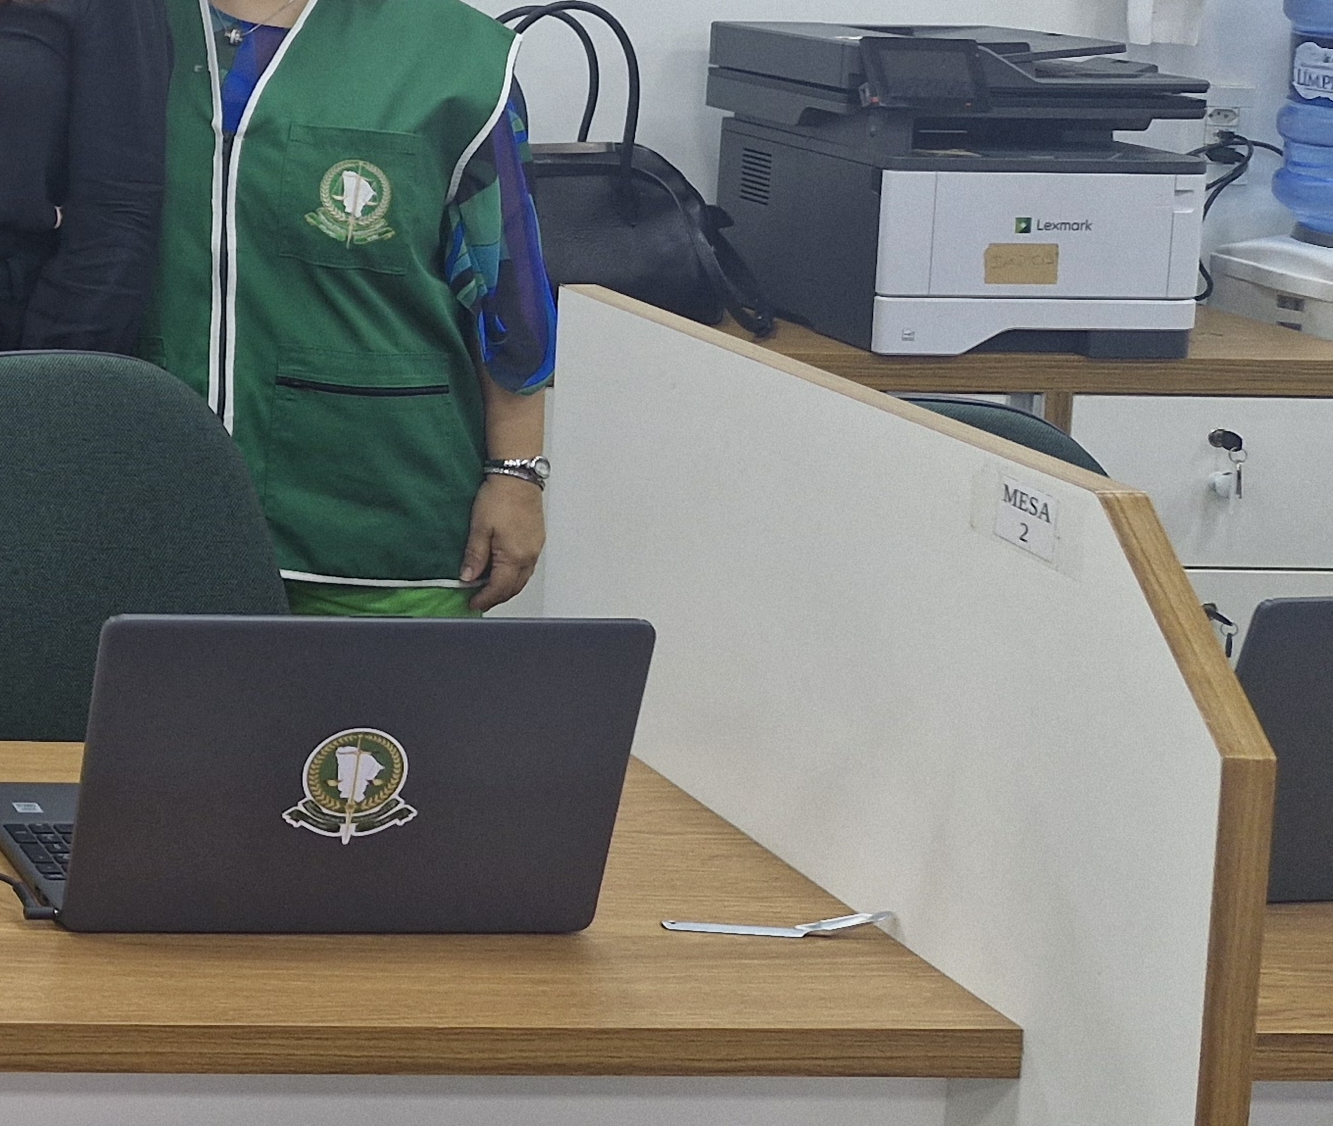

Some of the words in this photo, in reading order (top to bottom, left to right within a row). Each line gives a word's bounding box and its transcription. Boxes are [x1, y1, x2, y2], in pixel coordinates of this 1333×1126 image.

[1036, 219, 1093, 231] Lexmark
[1002, 483, 1051, 524] MESA
[1019, 522, 1029, 543] 2
